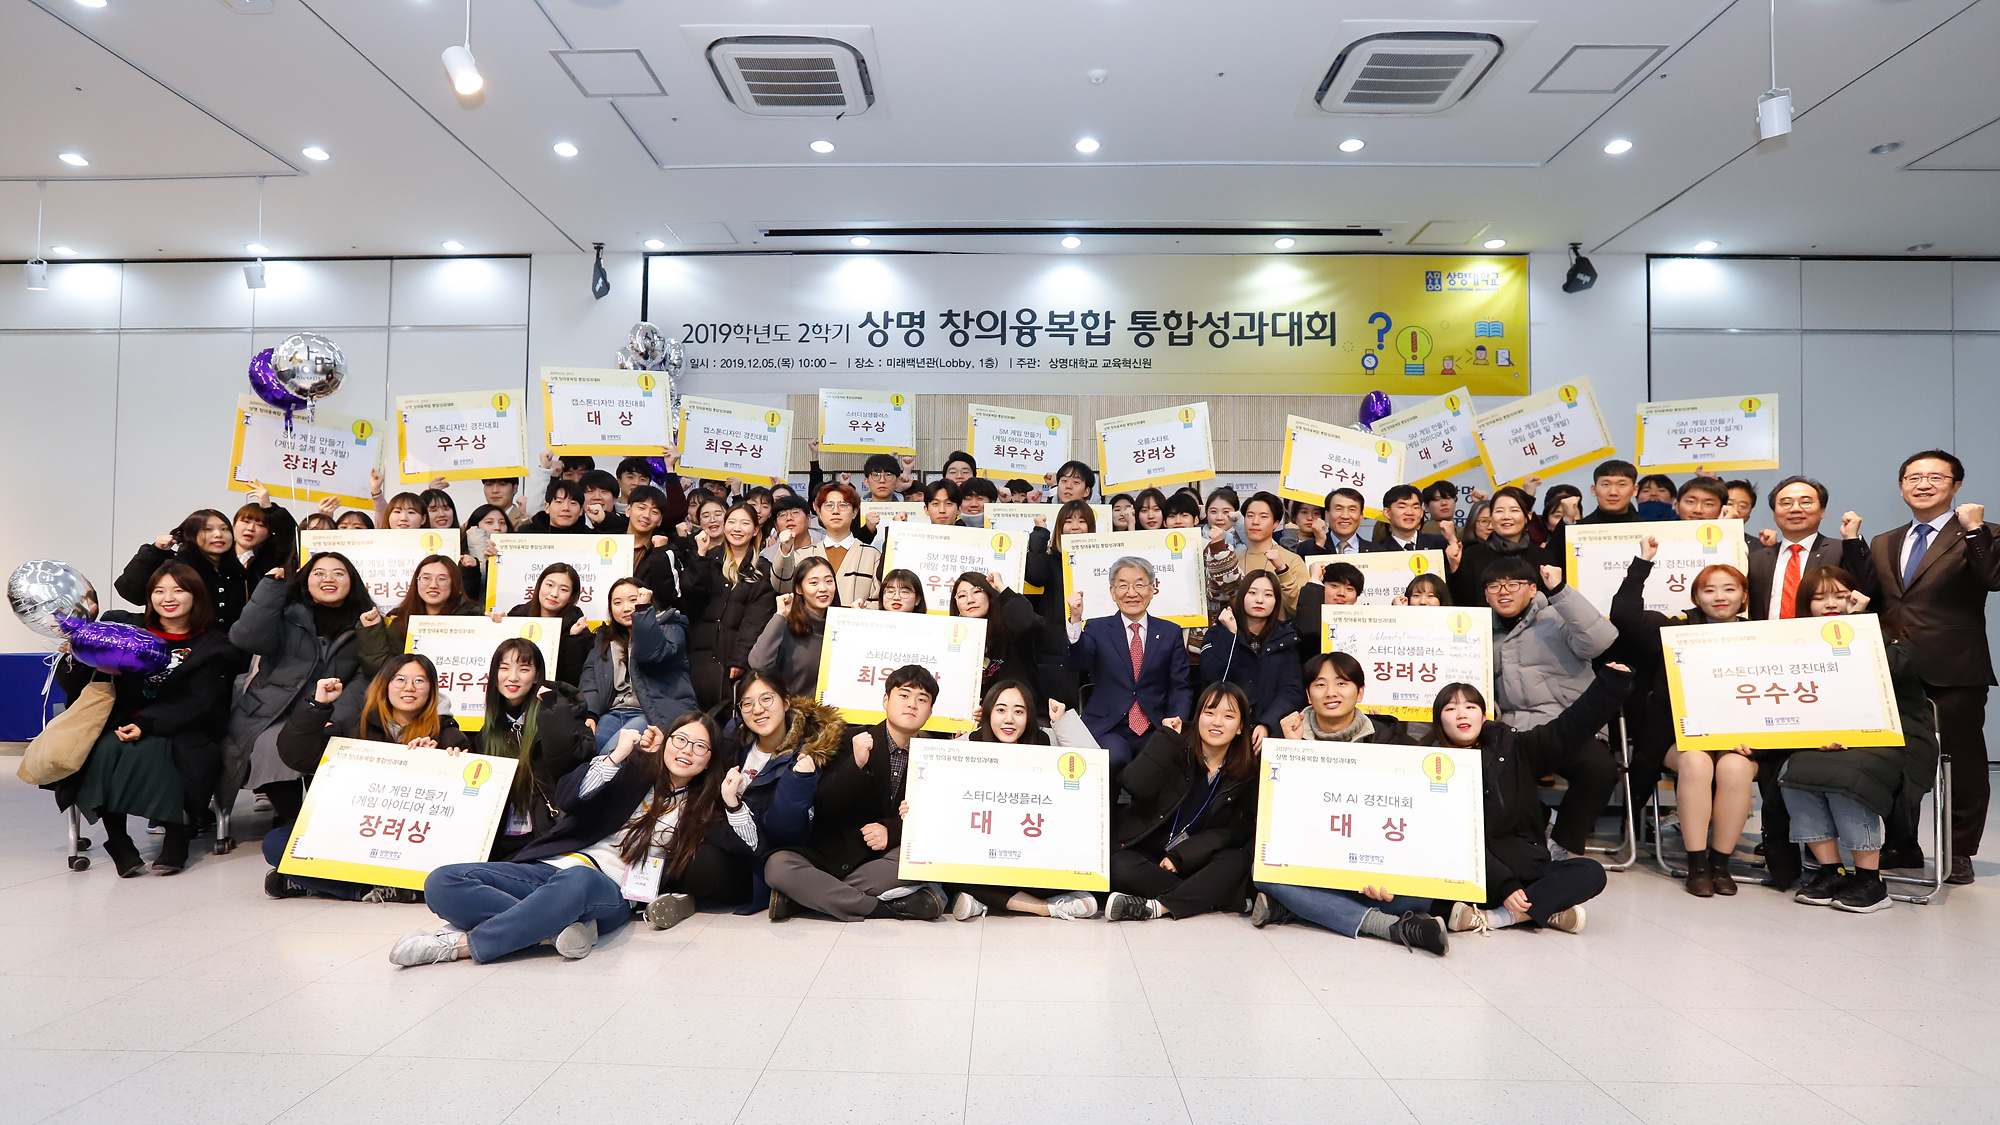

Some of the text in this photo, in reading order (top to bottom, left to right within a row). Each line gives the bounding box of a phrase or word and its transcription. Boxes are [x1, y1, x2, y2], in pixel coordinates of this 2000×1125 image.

[1446, 272, 1500, 286] 상명대학교
[681, 308, 1337, 348] 2019학년도 2학기 상명 창의융복합 통합성과대회
[689, 358, 709, 369] 일시
[720, 358, 795, 370] 2019.12.05.(목)
[798, 359, 827, 369] 10:00
[855, 358, 874, 369] 장소
[886, 357, 976, 370] 미래백년관(Lobby,
[978, 358, 999, 369] 1층)
[1015, 358, 1041, 369] 주관:
[1049, 357, 1099, 370] 상명대학교
[1102, 357, 1152, 369] 교육혁신원
[571, 398, 646, 408] 캡스톤디자인 경진대회
[587, 410, 633, 426] 대 상
[848, 420, 886, 433] 우수상
[1511, 412, 1561, 435] SM 게임 만들기
[424, 421, 499, 434] 캡스톤디자인 경진대회
[703, 426, 769, 442] 캡스톤디자인 경진대회
[1010, 429, 1023, 437] 게임
[1024, 430, 1042, 439] 만들기
[1408, 419, 1448, 440] SM 게임 만들기
[1509, 435, 1526, 446] (게임
[1528, 429, 1542, 439] 설계
[1553, 418, 1570, 429] 개발)
[320, 436, 344, 448] 만들기
[437, 434, 487, 452] 우수상
[992, 435, 1048, 447] (게임 아이디어 설계)
[1137, 434, 1169, 446] 오름스타트
[1406, 425, 1457, 450] (게임 아이디어 설계)
[1523, 432, 1565, 455] 대 상
[1678, 435, 1729, 449] 우수상
[299, 442, 318, 454] 설계
[319, 446, 328, 456] 및
[330, 448, 350, 459] 개발)
[705, 438, 763, 459] 최우수상
[993, 445, 1045, 462] 최우수상
[1132, 444, 1176, 464] 장려상
[1419, 438, 1453, 460] 대 상
[282, 454, 338, 476] 장려상
[1327, 453, 1361, 467] 오름스타트
[1319, 463, 1366, 487] 우수상
[367, 559, 384, 567] 게임
[388, 558, 414, 567] 만들기
[920, 562, 938, 571] (게임
[941, 564, 957, 572] 설계
[942, 554, 957, 563] 게임
[960, 555, 984, 565] 만들기
[1603, 559, 1706, 570] 캡스톤인 경진대회
[368, 569, 396, 577] 설계 및
[1666, 574, 1687, 592] 상
[865, 650, 938, 664] 스터디상생플러스
[1368, 646, 1445, 656] 스터디상생플러스
[434, 655, 486, 667] 캡스톤디자인
[1711, 661, 1839, 678] 캡스톤디자인 경진대회
[1373, 661, 1439, 682] 장려상
[1735, 680, 1819, 705] 우수상
[368, 782, 448, 802] SM 게임 만들기
[962, 790, 1053, 806] 스터디상생플러스
[1323, 792, 1413, 809] SM AI 경진대회
[351, 793, 455, 818] (게임 아이디어 설계)
[359, 814, 431, 844] 장려상
[970, 810, 1045, 838] 대 상
[1330, 814, 1407, 842] 대 상
